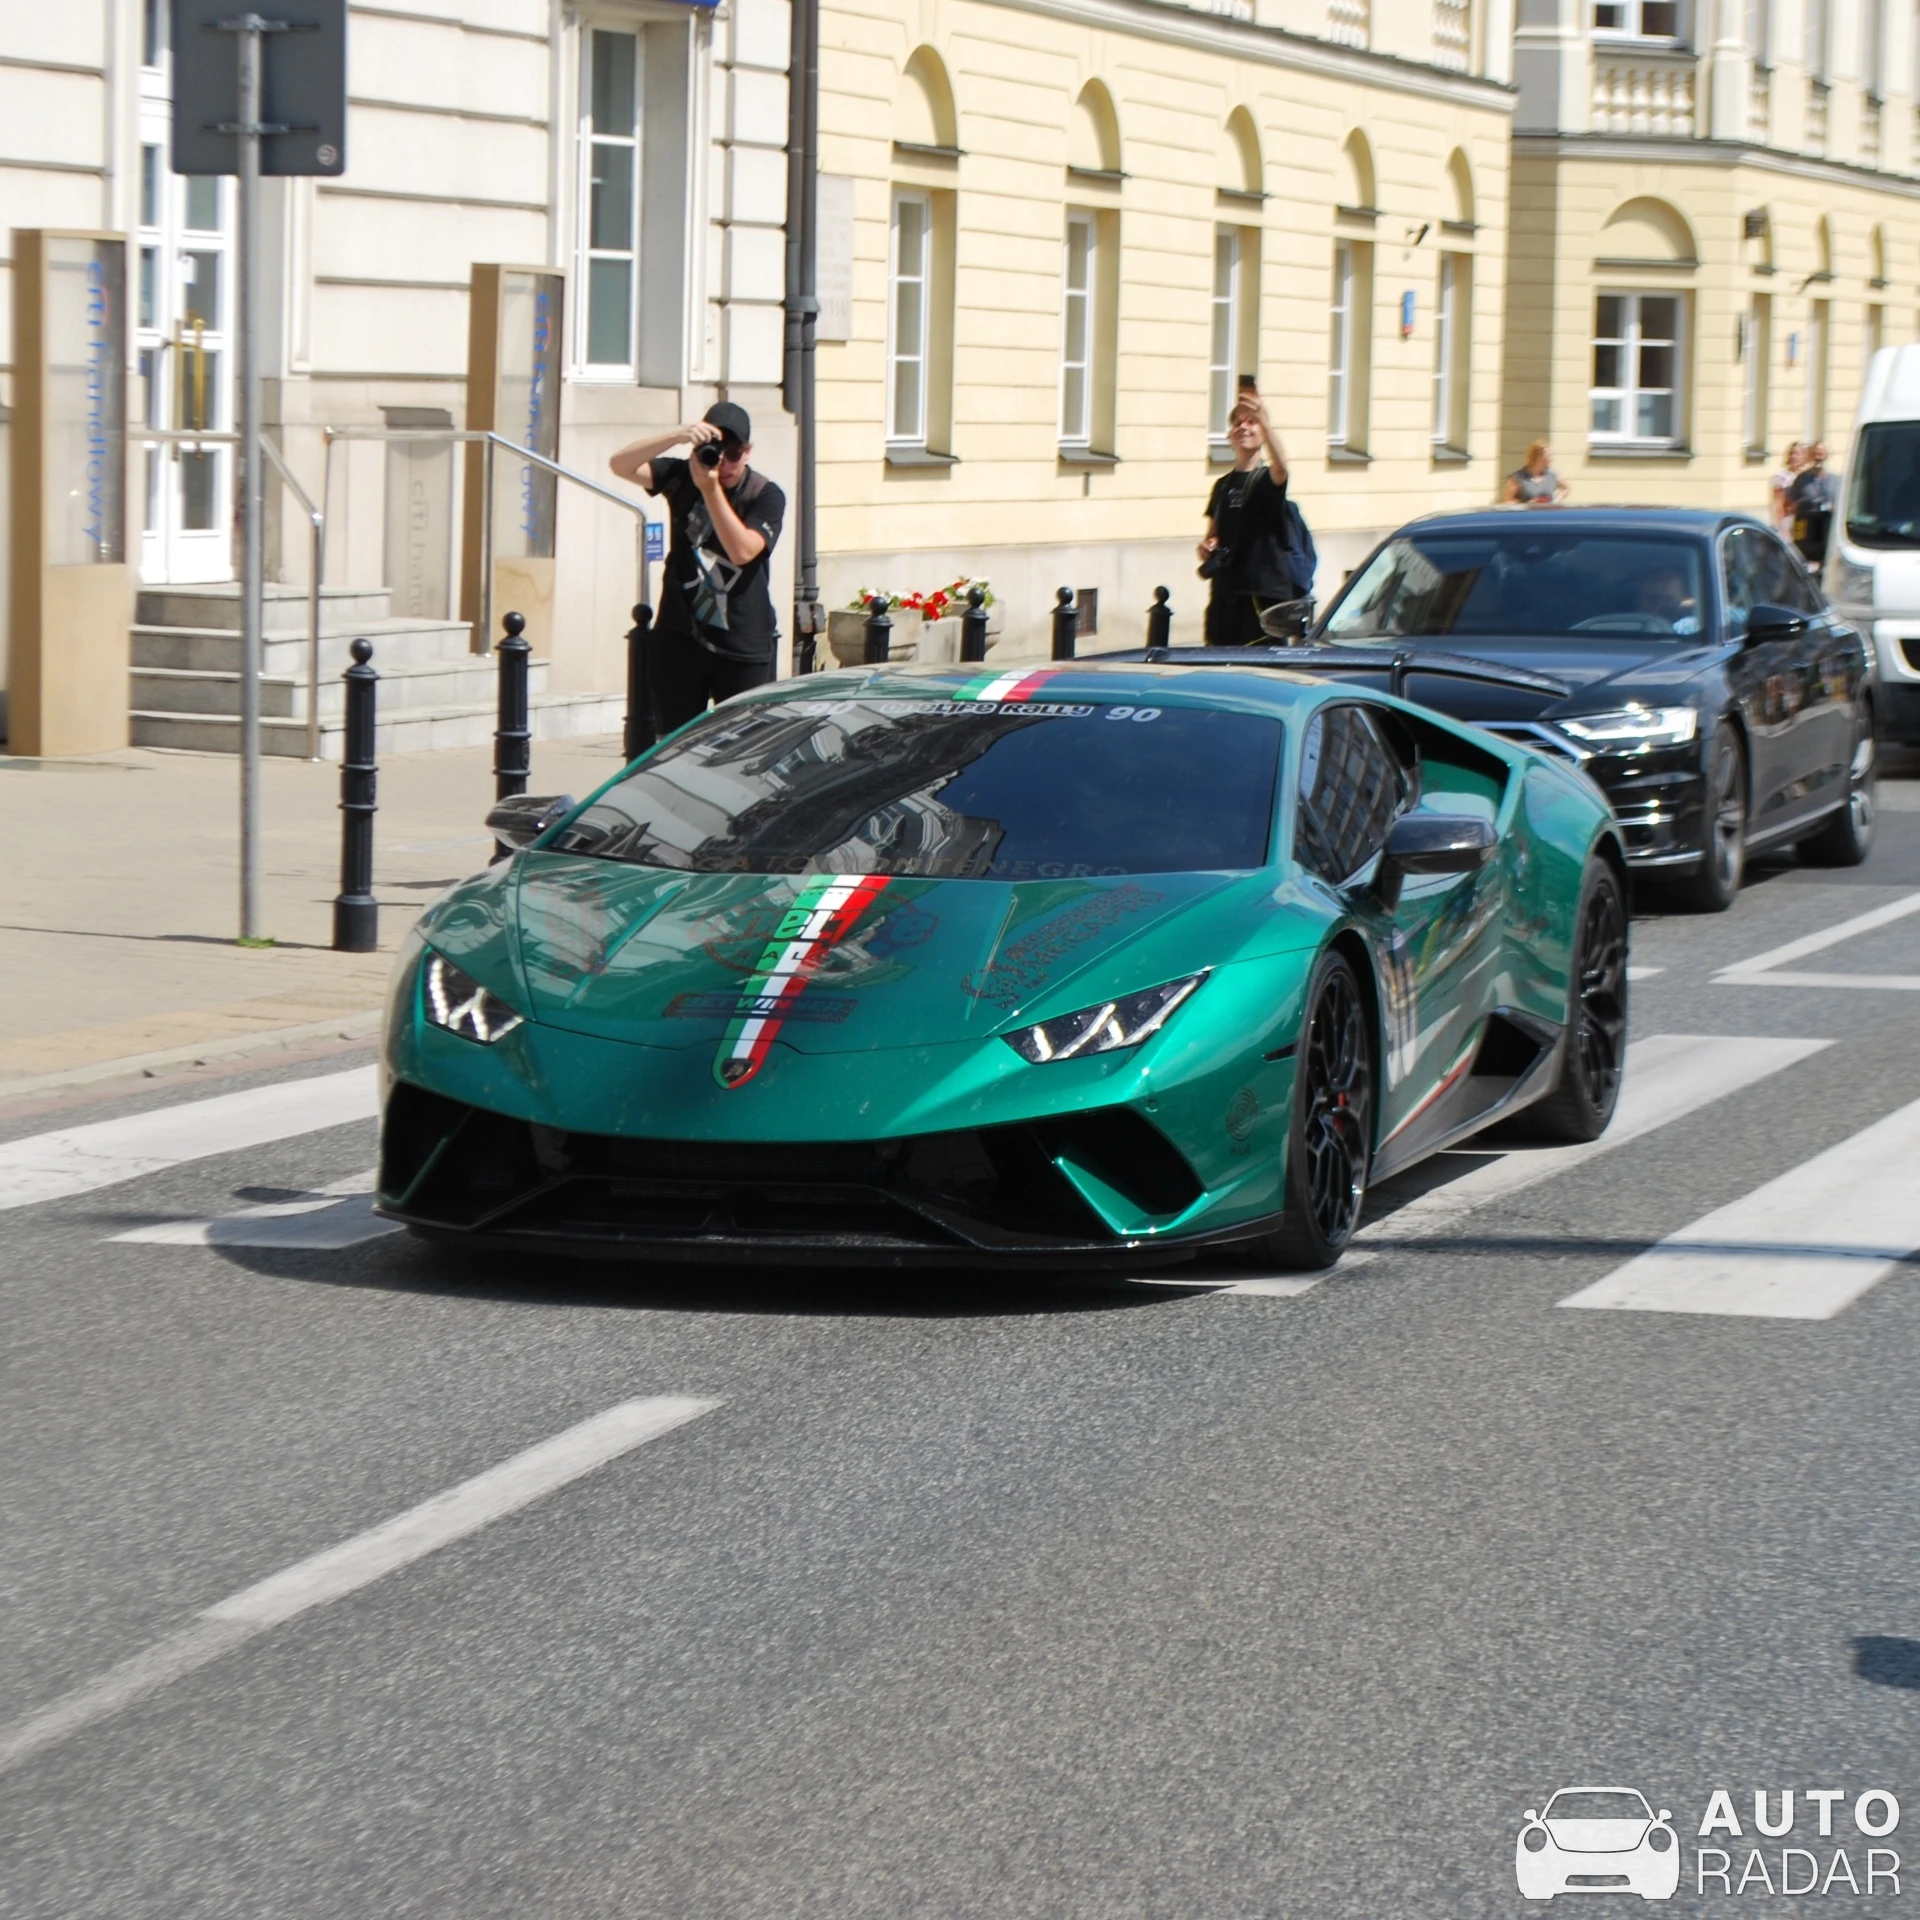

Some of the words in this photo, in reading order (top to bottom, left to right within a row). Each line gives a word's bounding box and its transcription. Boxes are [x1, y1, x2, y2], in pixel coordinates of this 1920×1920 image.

[82, 341, 108, 543] handlowy
[411, 480, 430, 532] citi
[1104, 705, 1163, 723] 90
